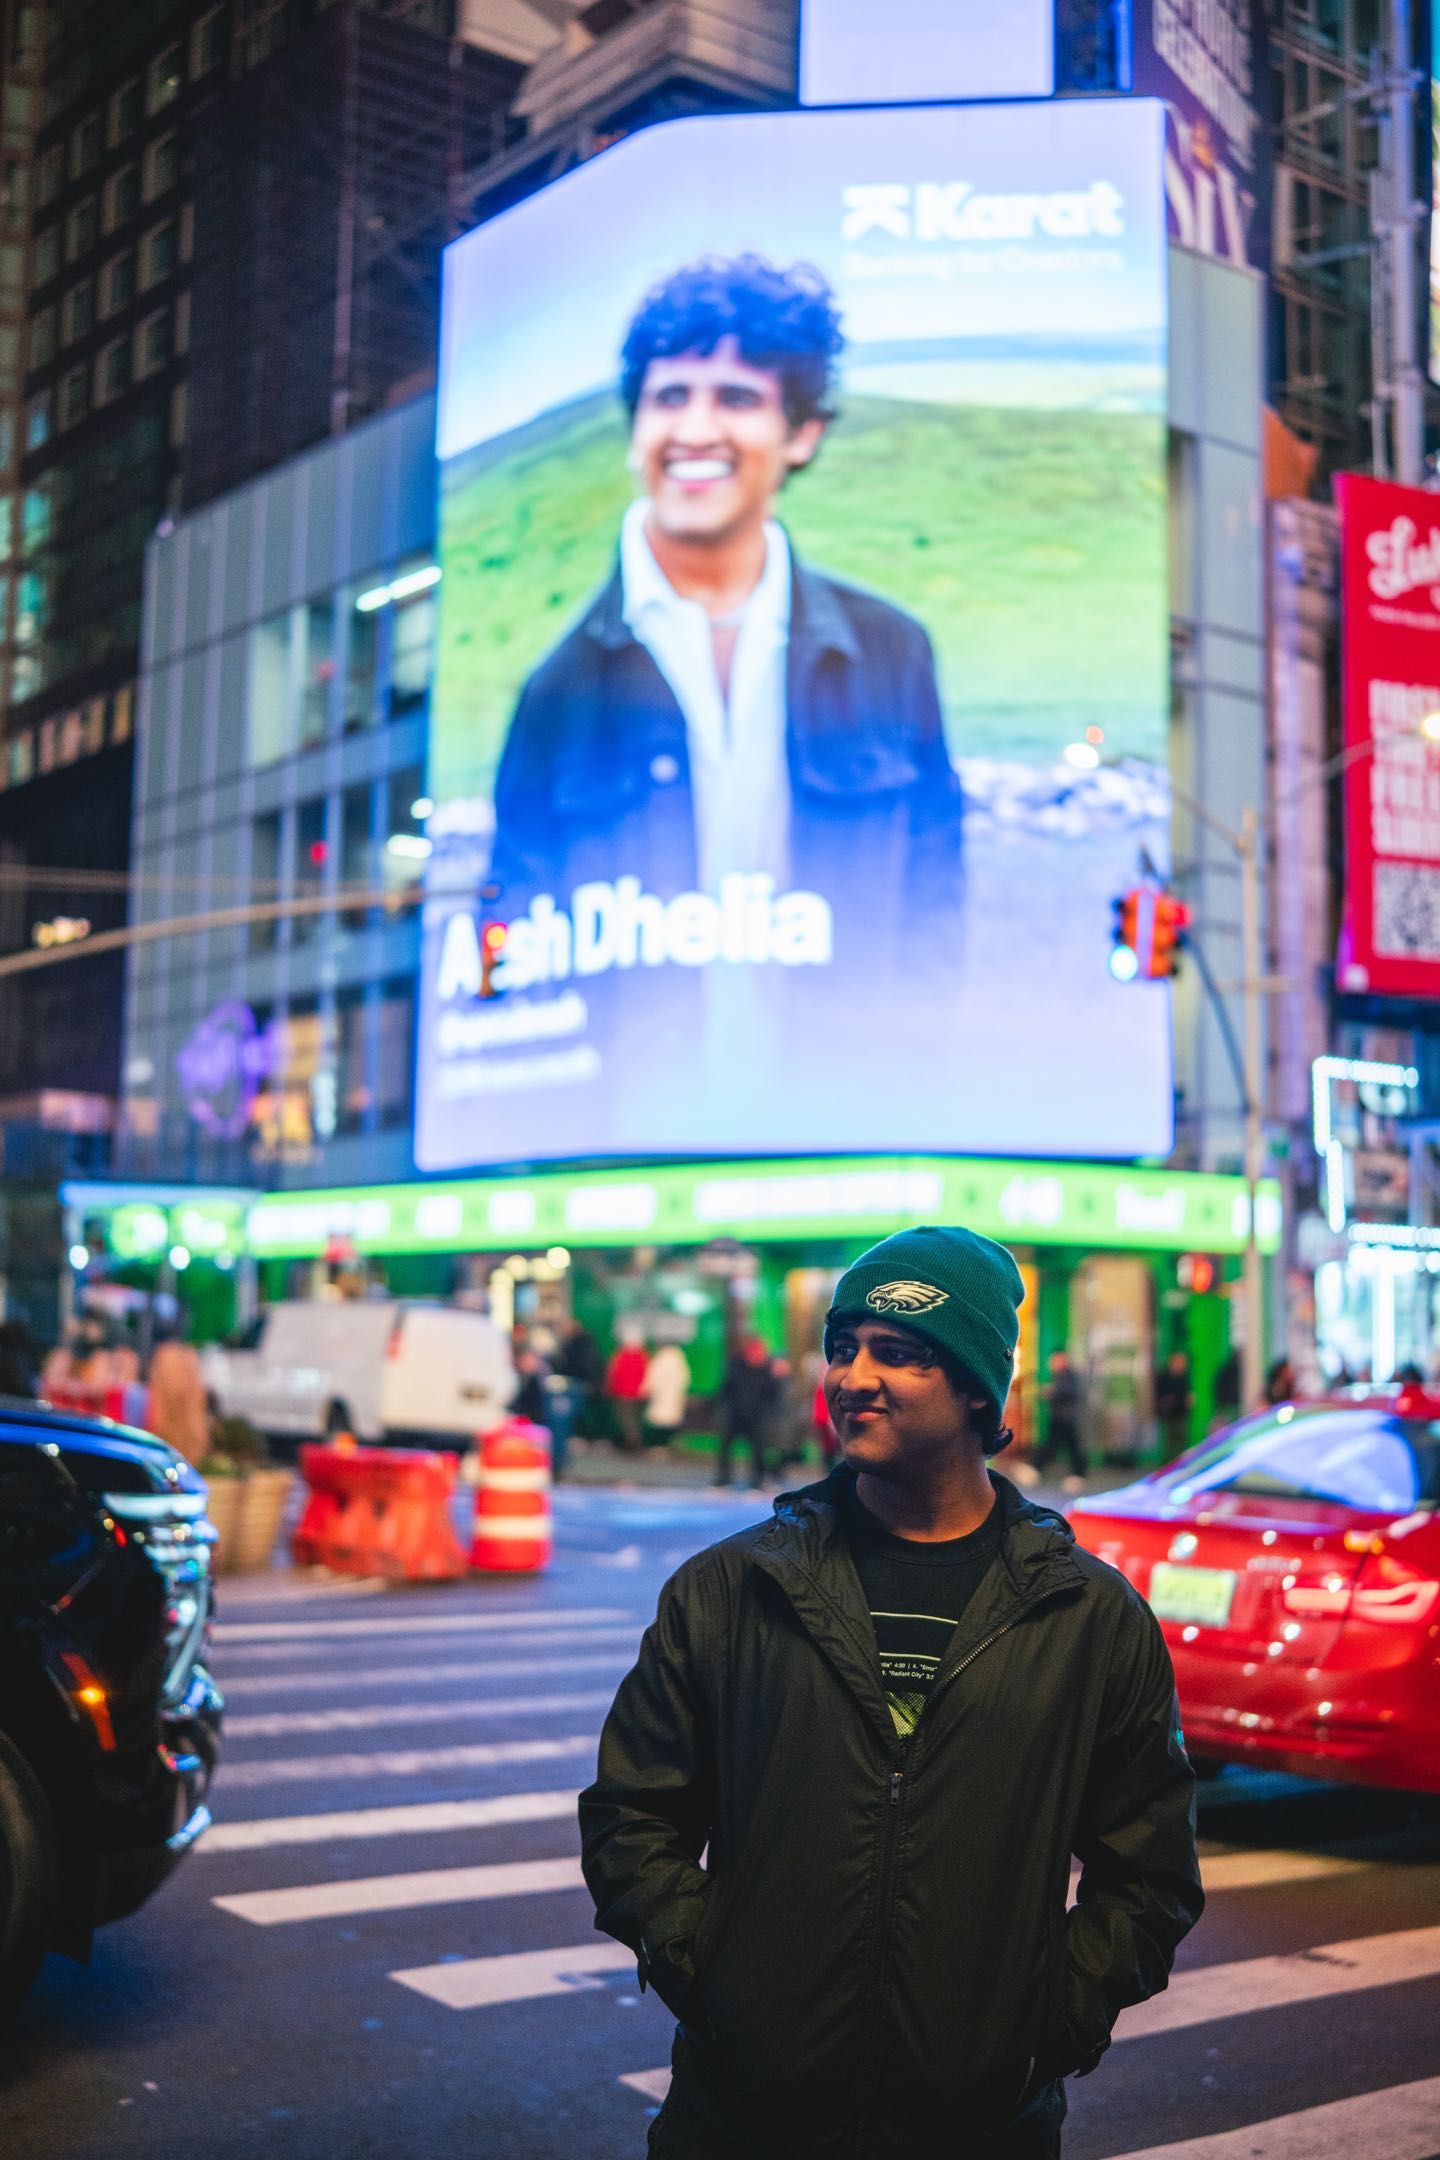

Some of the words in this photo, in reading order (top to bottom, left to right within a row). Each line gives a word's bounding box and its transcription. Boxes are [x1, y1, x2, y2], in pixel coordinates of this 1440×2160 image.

[914, 180, 1125, 240] Karat
[438, 892, 572, 999] Ash
[911, 1671, 925, 1679] City"
